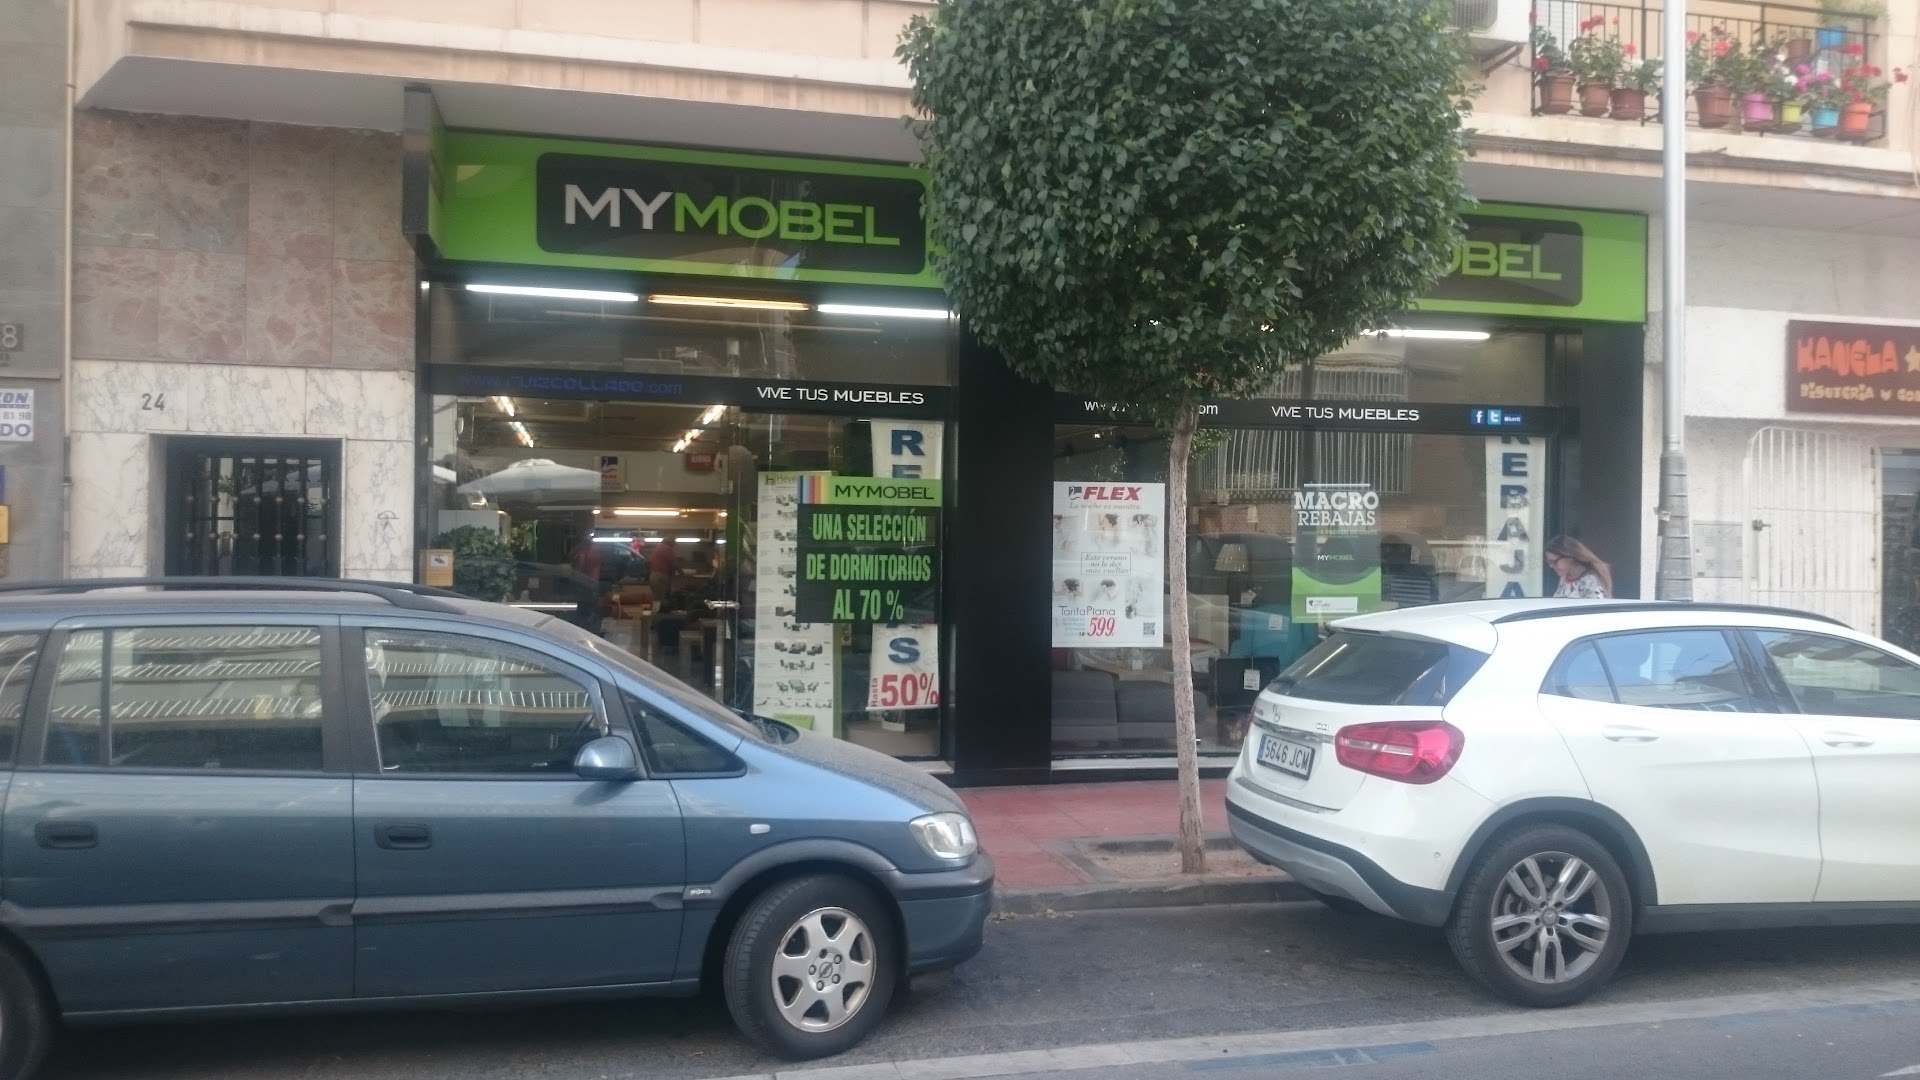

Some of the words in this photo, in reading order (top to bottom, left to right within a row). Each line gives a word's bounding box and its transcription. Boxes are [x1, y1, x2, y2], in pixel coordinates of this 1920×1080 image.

[565, 184, 900, 246] MYMOBEL
[1797, 336, 1899, 377] KANELA
[0, 392, 30, 404] ON
[142, 392, 166, 411] 24
[757, 386, 792, 400] VIVE
[796, 388, 829, 402] TUS
[834, 389, 925, 405] MUEBLES
[18, 411, 32, 421] 98
[1271, 406, 1301, 418] VIVE
[1305, 407, 1334, 419] TUS
[1338, 408, 1420, 421] MUEBLES
[834, 484, 935, 500] MYMOBEL
[1083, 486, 1142, 501] FLEX
[1294, 491, 1379, 510] MACRO
[812, 513, 843, 541] UNA
[846, 508, 927, 542] SELECCIÓN
[1297, 510, 1376, 526] REBAJAS
[806, 553, 826, 580] DE
[830, 553, 932, 582] DORMITORIOS
[832, 588, 855, 620] AL
[860, 588, 881, 621] 70
[886, 589, 904, 621] %
[881, 672, 940, 708] 50%
[1265, 740, 1288, 764] 5646
[1289, 748, 1310, 770] JCM
